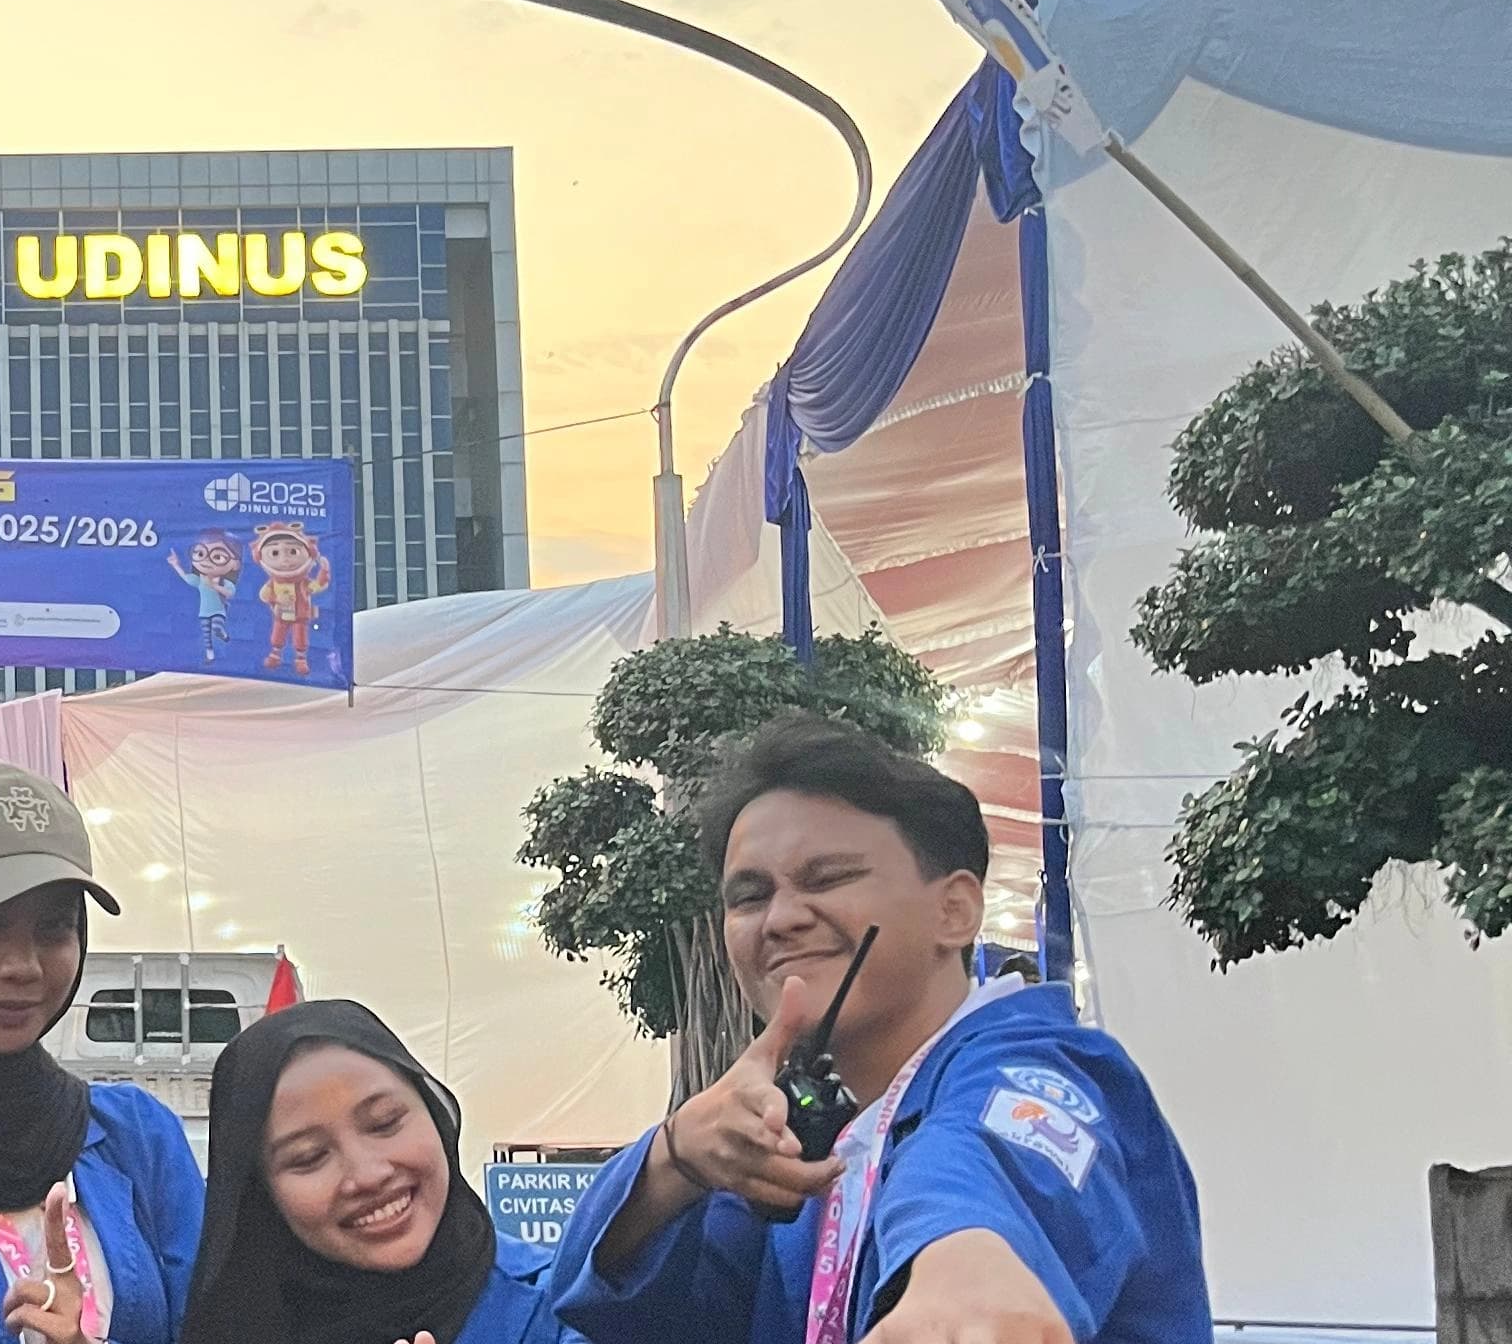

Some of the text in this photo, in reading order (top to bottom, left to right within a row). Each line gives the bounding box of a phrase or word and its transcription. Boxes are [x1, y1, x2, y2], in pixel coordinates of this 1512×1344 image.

[17, 231, 368, 299] UDINUS
[252, 481, 325, 506] 2025
[239, 503, 327, 517] DINUS INSIDE
[498, 1173, 571, 1190] PARKIR
[500, 1197, 576, 1215] CIVITAS
